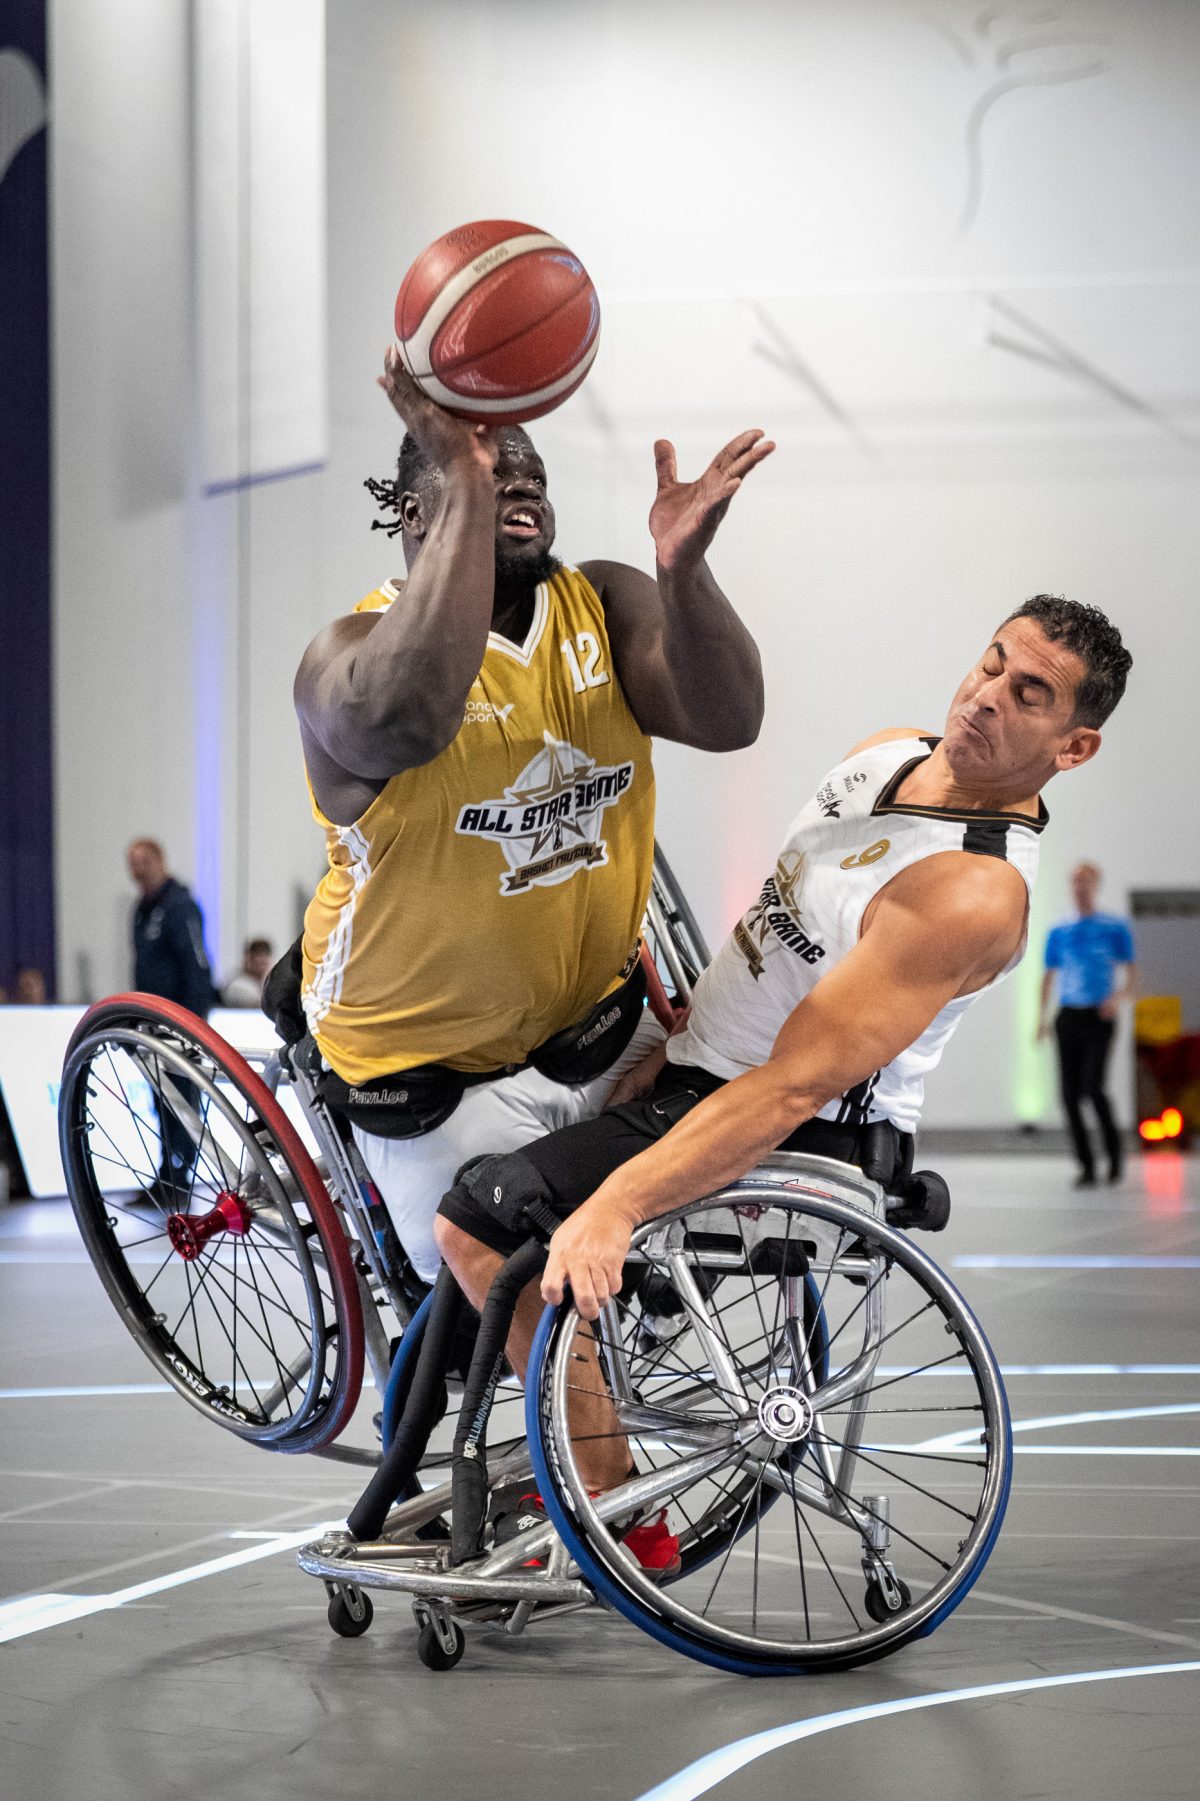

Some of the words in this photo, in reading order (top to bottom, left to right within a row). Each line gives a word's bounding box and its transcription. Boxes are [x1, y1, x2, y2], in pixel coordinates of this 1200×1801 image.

[561, 631, 610, 694] 12
[460, 808, 513, 834] ALL
[520, 791, 573, 832] STAR
[520, 859, 555, 881] BASKET
[840, 839, 891, 869] 9
[767, 912, 826, 965] GAME
